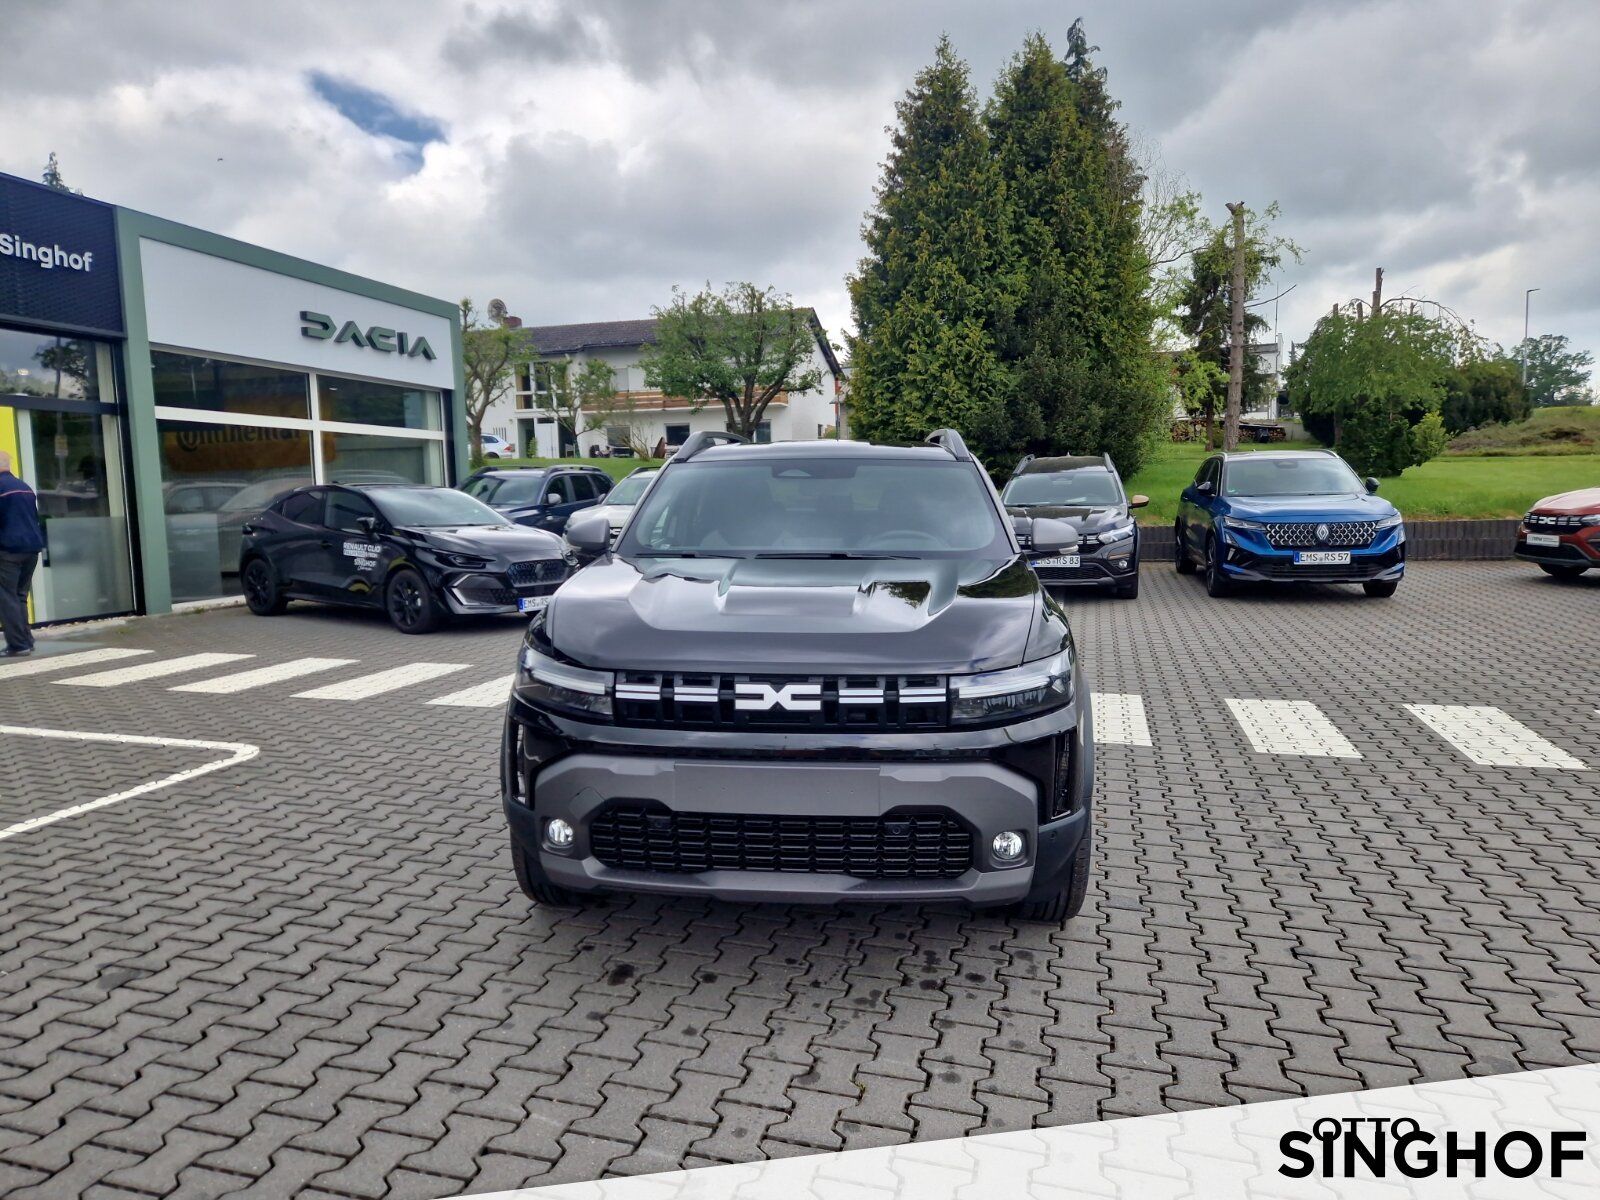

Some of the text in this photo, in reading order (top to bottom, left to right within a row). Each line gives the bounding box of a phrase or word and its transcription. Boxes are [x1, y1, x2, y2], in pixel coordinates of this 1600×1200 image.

[0, 233, 93, 272] Singhof
[299, 310, 437, 361] DACIA
[343, 542, 367, 551] RENAULT
[1069, 556, 1080, 565] 83
[1300, 552, 1349, 562] EMS RS 57
